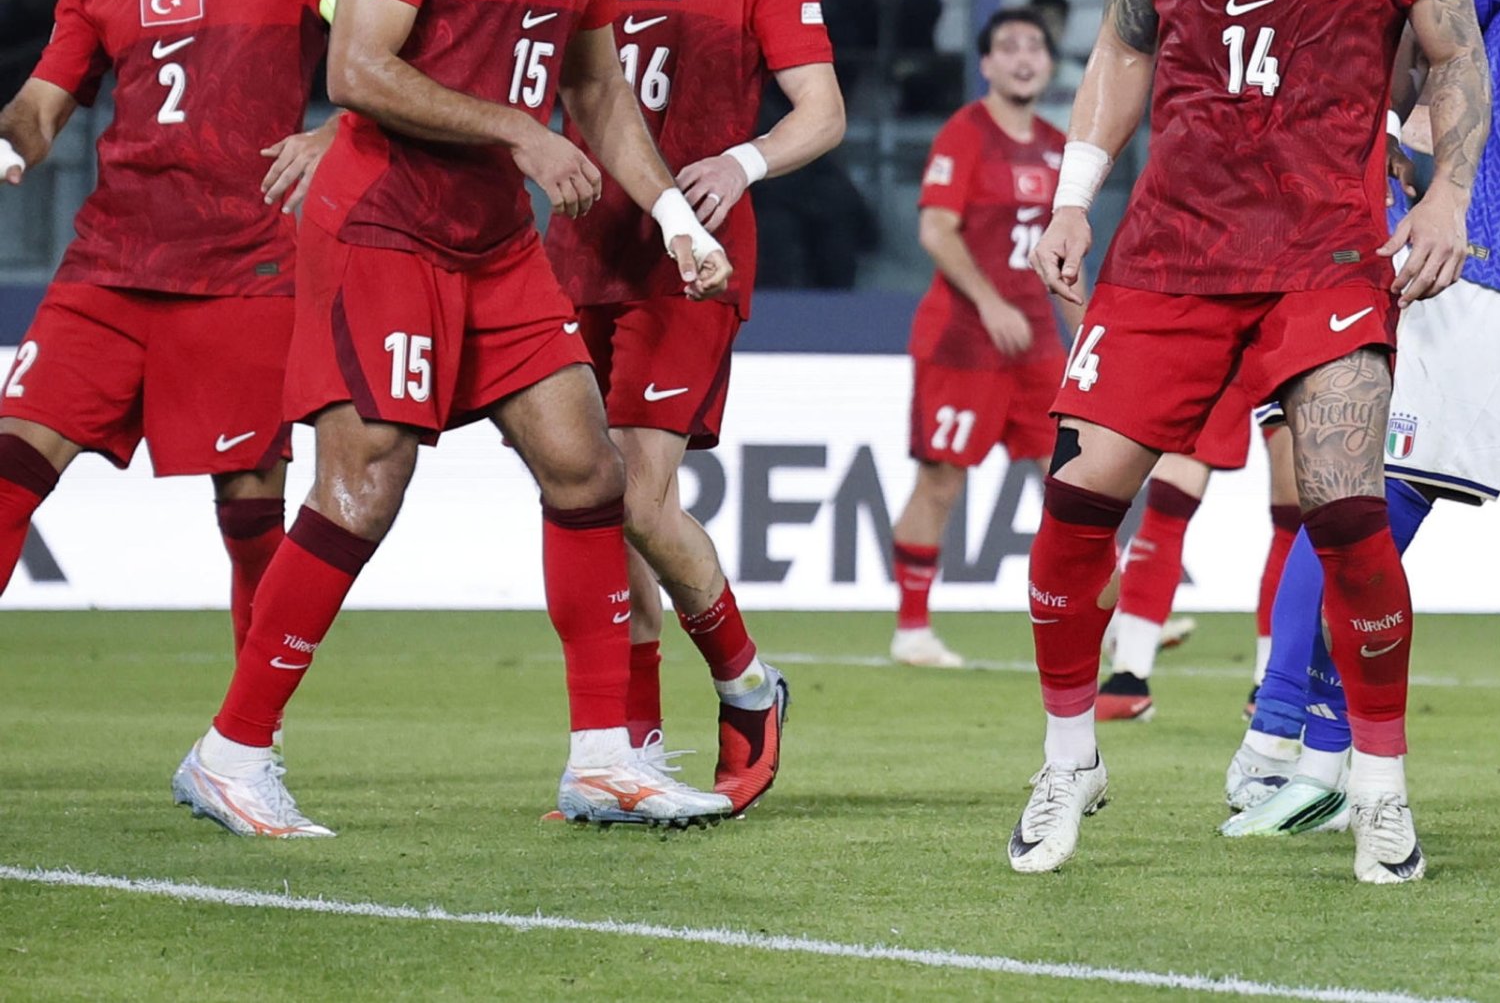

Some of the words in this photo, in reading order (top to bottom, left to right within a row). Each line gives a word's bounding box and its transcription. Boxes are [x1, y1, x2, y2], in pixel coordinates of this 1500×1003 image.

[157, 62, 186, 124] 2
[508, 38, 555, 109] 15
[619, 43, 671, 111] 16
[1221, 25, 1280, 97] 14
[5, 340, 38, 398] 2
[384, 331, 433, 402] 15
[931, 405, 976, 454] 21
[1350, 610, 1404, 633] TÜRKİYE
